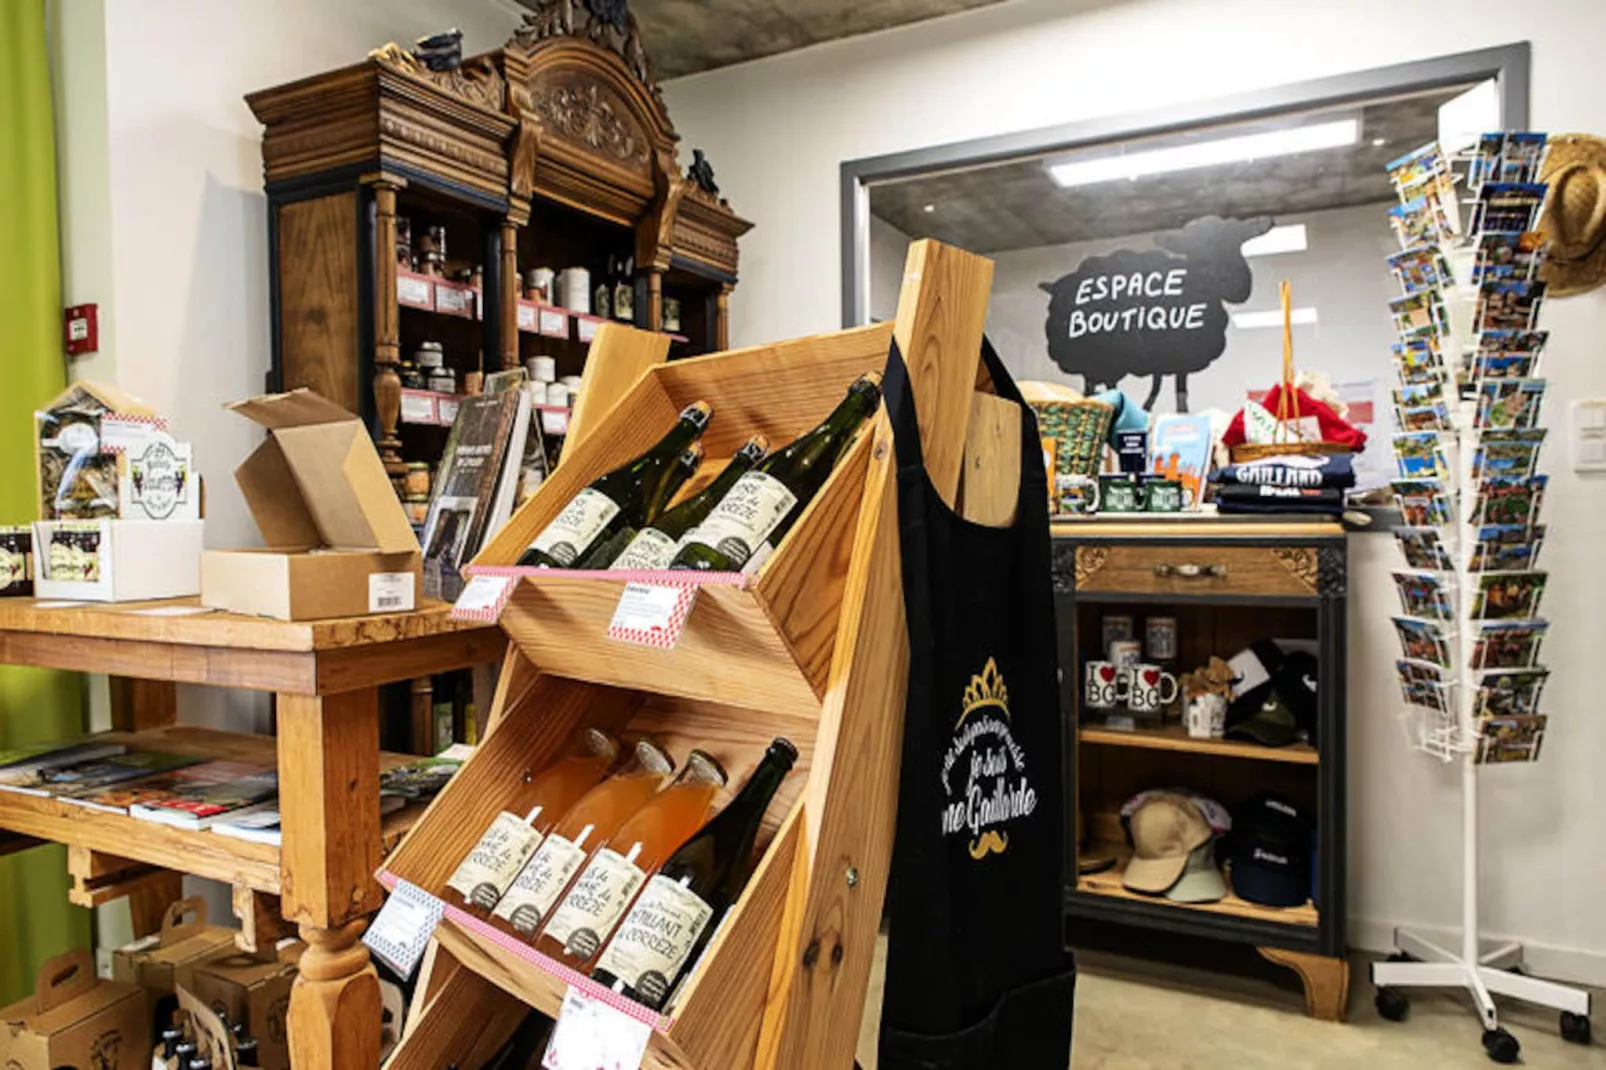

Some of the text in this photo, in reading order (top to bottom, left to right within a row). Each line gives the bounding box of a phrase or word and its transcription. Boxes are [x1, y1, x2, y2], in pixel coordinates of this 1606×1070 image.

[1074, 268, 1188, 305] ESPACE
[1068, 302, 1208, 338] BOUTIQUE
[1089, 683, 1117, 704] BG
[1132, 687, 1159, 707] BG
